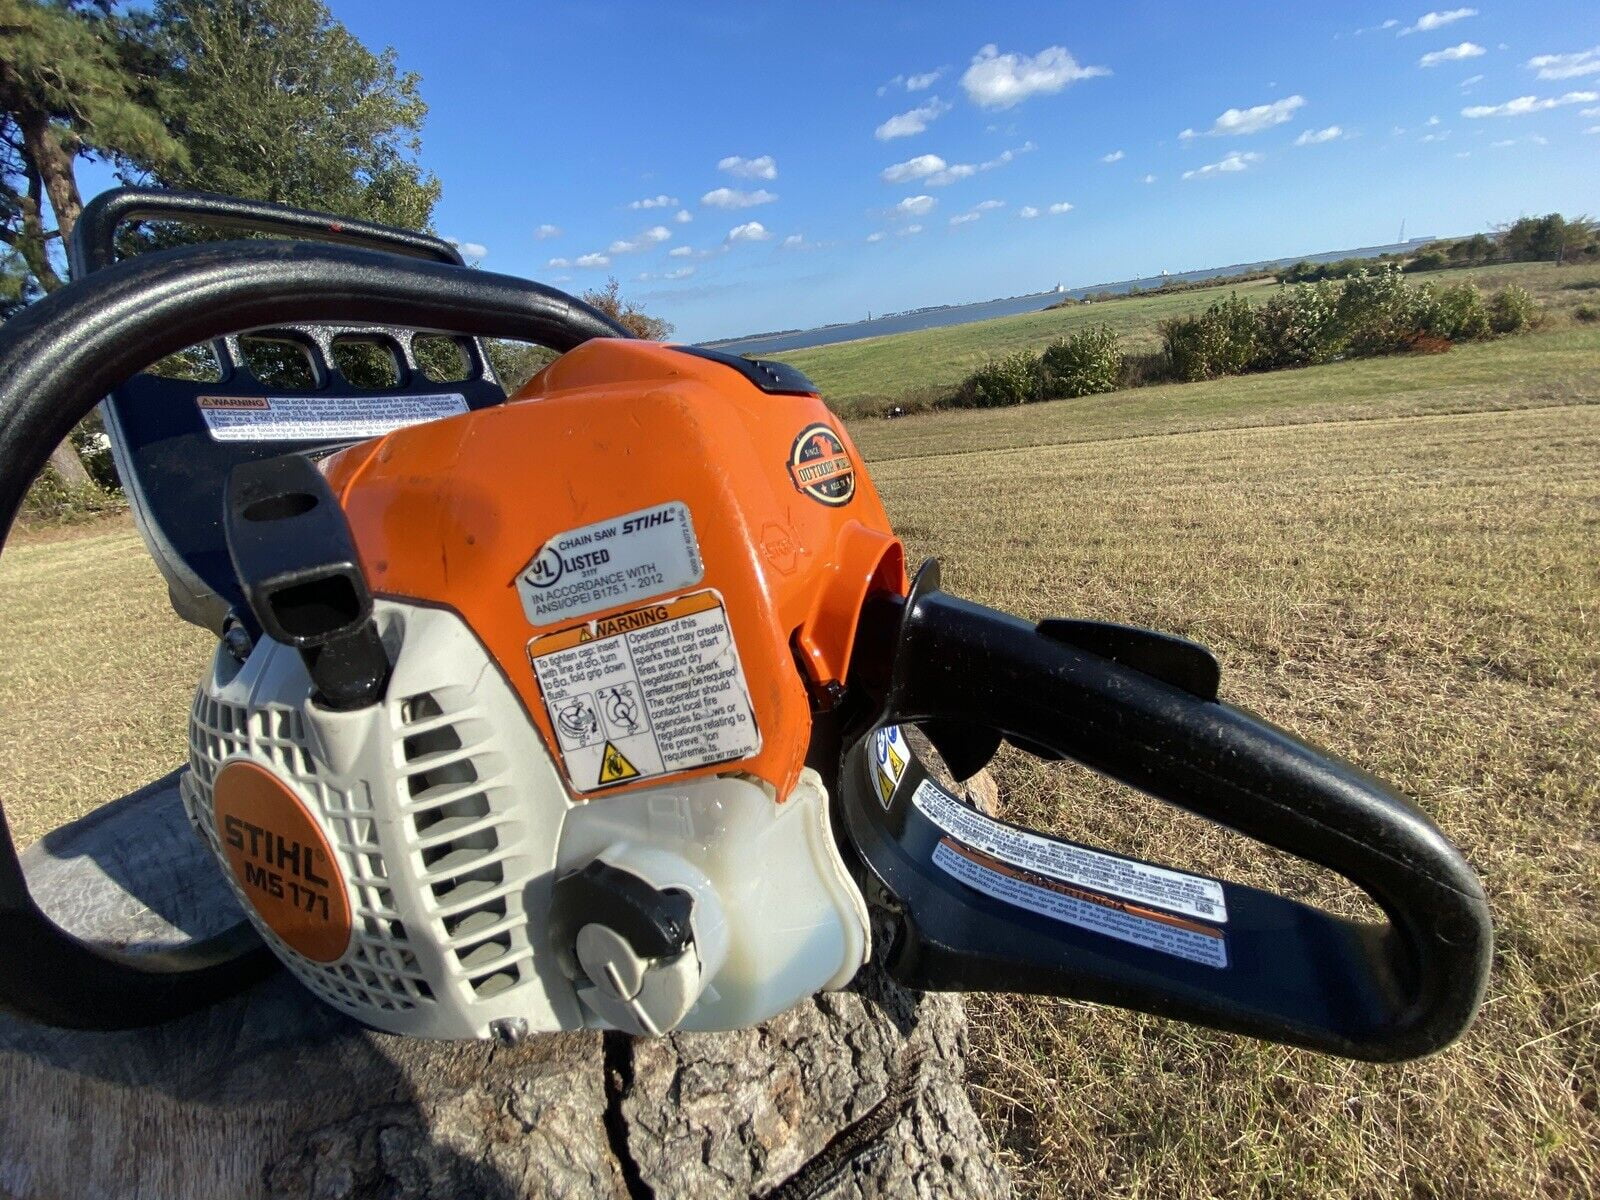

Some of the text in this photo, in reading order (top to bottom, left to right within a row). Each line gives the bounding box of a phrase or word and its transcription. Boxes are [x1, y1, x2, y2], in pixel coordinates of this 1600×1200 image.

[558, 535, 591, 549] CHAIN
[594, 527, 617, 540] SAW
[622, 510, 675, 534] STIHL
[532, 548, 609, 578] UL LISTED
[531, 563, 655, 604] IN ACCORDANCE WITH
[535, 592, 590, 615] ANSI/OPEI
[593, 582, 627, 600] B175.1
[637, 572, 663, 588] 2012
[594, 606, 668, 637] WARNING
[628, 618, 696, 645] Operation of this
[536, 658, 548, 668] To
[596, 639, 619, 652] insert
[631, 623, 724, 655] equipment may create
[635, 636, 718, 665] sparks that can start
[540, 662, 583, 678] with line at
[569, 661, 625, 682] fold grip down
[601, 653, 616, 662] turn
[638, 652, 702, 675] fires around dry
[543, 680, 552, 689] to
[641, 659, 719, 688] vegetation. A spark
[644, 683, 673, 697] arrester
[674, 680, 691, 691] may
[691, 675, 702, 685] be
[648, 680, 730, 707] The operator should
[651, 695, 717, 718] contact local fire
[654, 714, 691, 731] agencies
[726, 703, 737, 712] or
[657, 711, 746, 742] regulations relating to
[660, 741, 673, 750] fire
[225, 814, 329, 888] STIHL
[245, 861, 329, 920] MS 171
